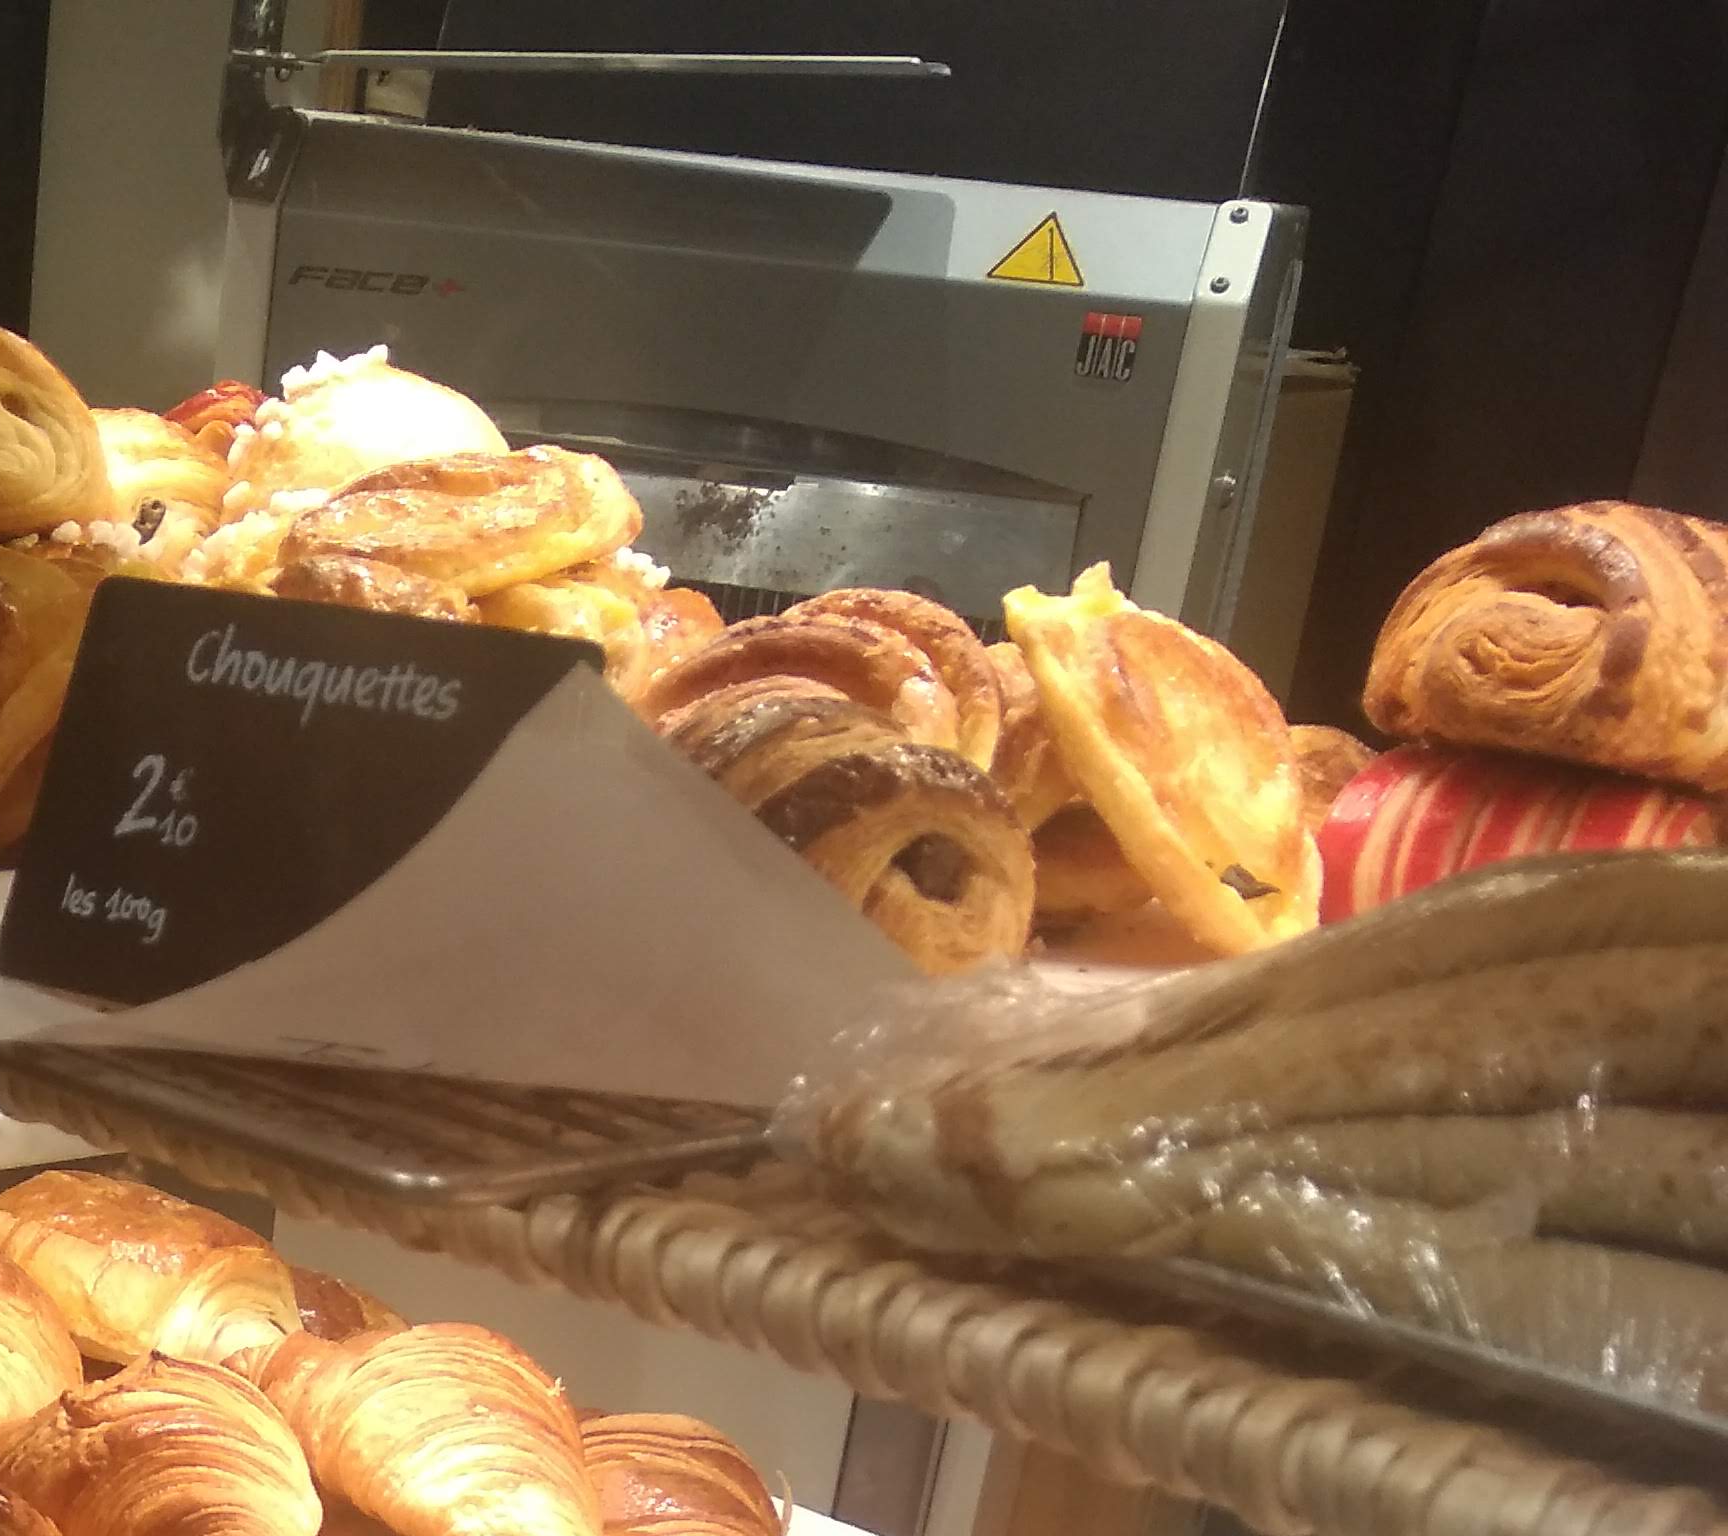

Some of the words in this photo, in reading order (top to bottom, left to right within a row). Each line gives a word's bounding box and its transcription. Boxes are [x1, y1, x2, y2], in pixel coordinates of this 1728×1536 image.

[185, 621, 463, 729] Chouquettes
[60, 871, 98, 918] les
[104, 886, 168, 945] 100g
